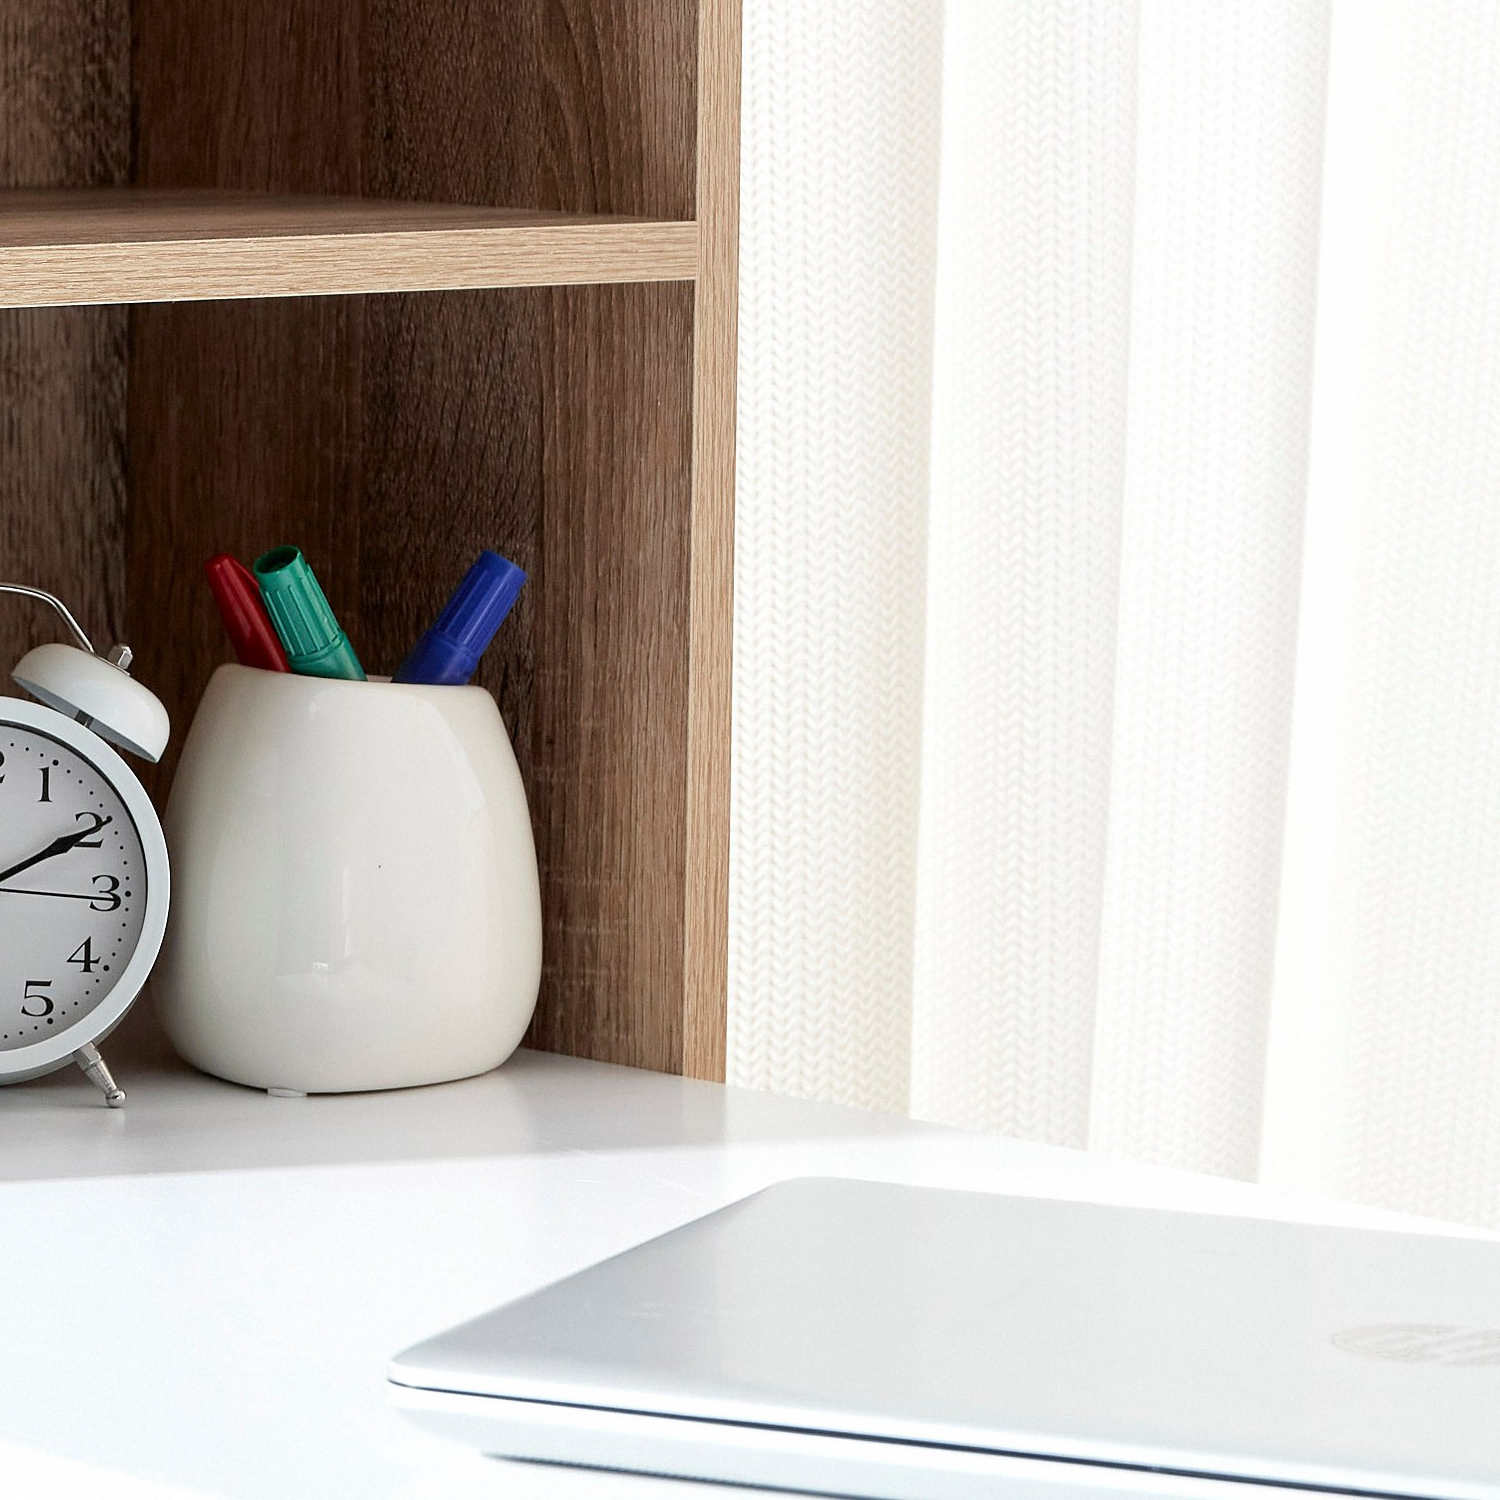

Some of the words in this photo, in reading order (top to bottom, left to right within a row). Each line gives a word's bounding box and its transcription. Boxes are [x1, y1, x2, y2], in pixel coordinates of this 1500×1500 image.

[38, 766, 53, 803] 1
[74, 811, 104, 849] 2
[89, 874, 122, 912] 3
[66, 936, 101, 973] 4
[20, 980, 54, 1017] 5
